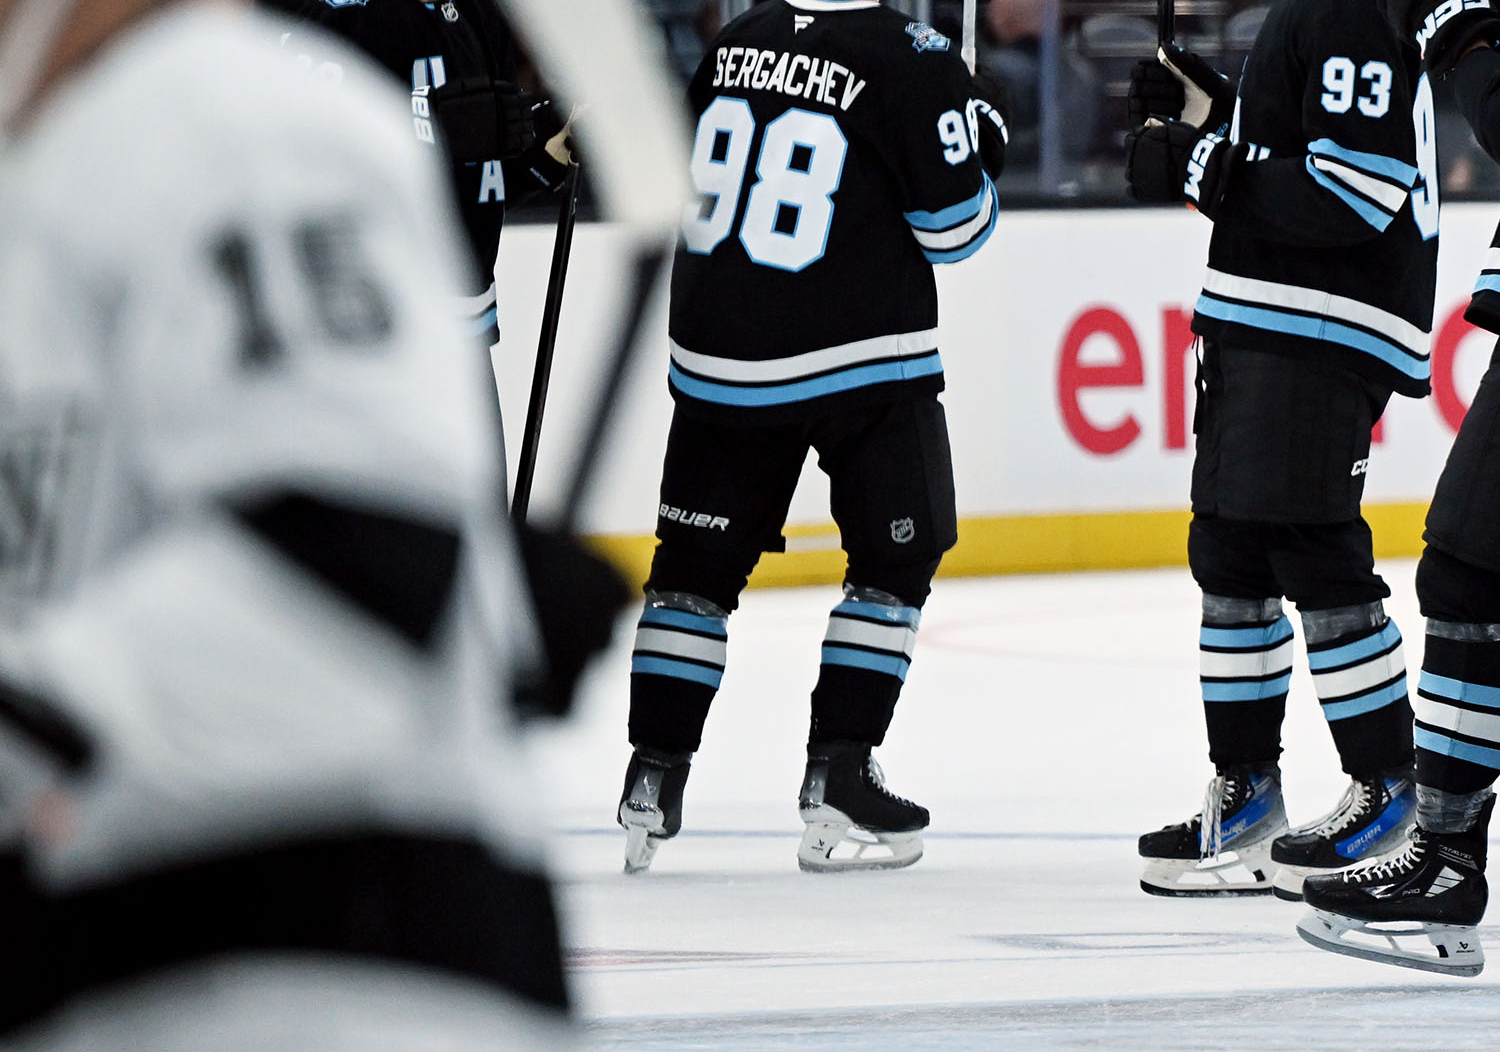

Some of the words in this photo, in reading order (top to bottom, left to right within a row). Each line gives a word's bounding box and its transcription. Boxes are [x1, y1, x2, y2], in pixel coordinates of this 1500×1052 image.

[713, 47, 865, 111] SERGACHEV
[1321, 56, 1393, 118] 93
[478, 159, 505, 204] A
[681, 95, 849, 273] 98
[659, 503, 730, 532] BAUER
[1346, 824, 1382, 854] BAUER
